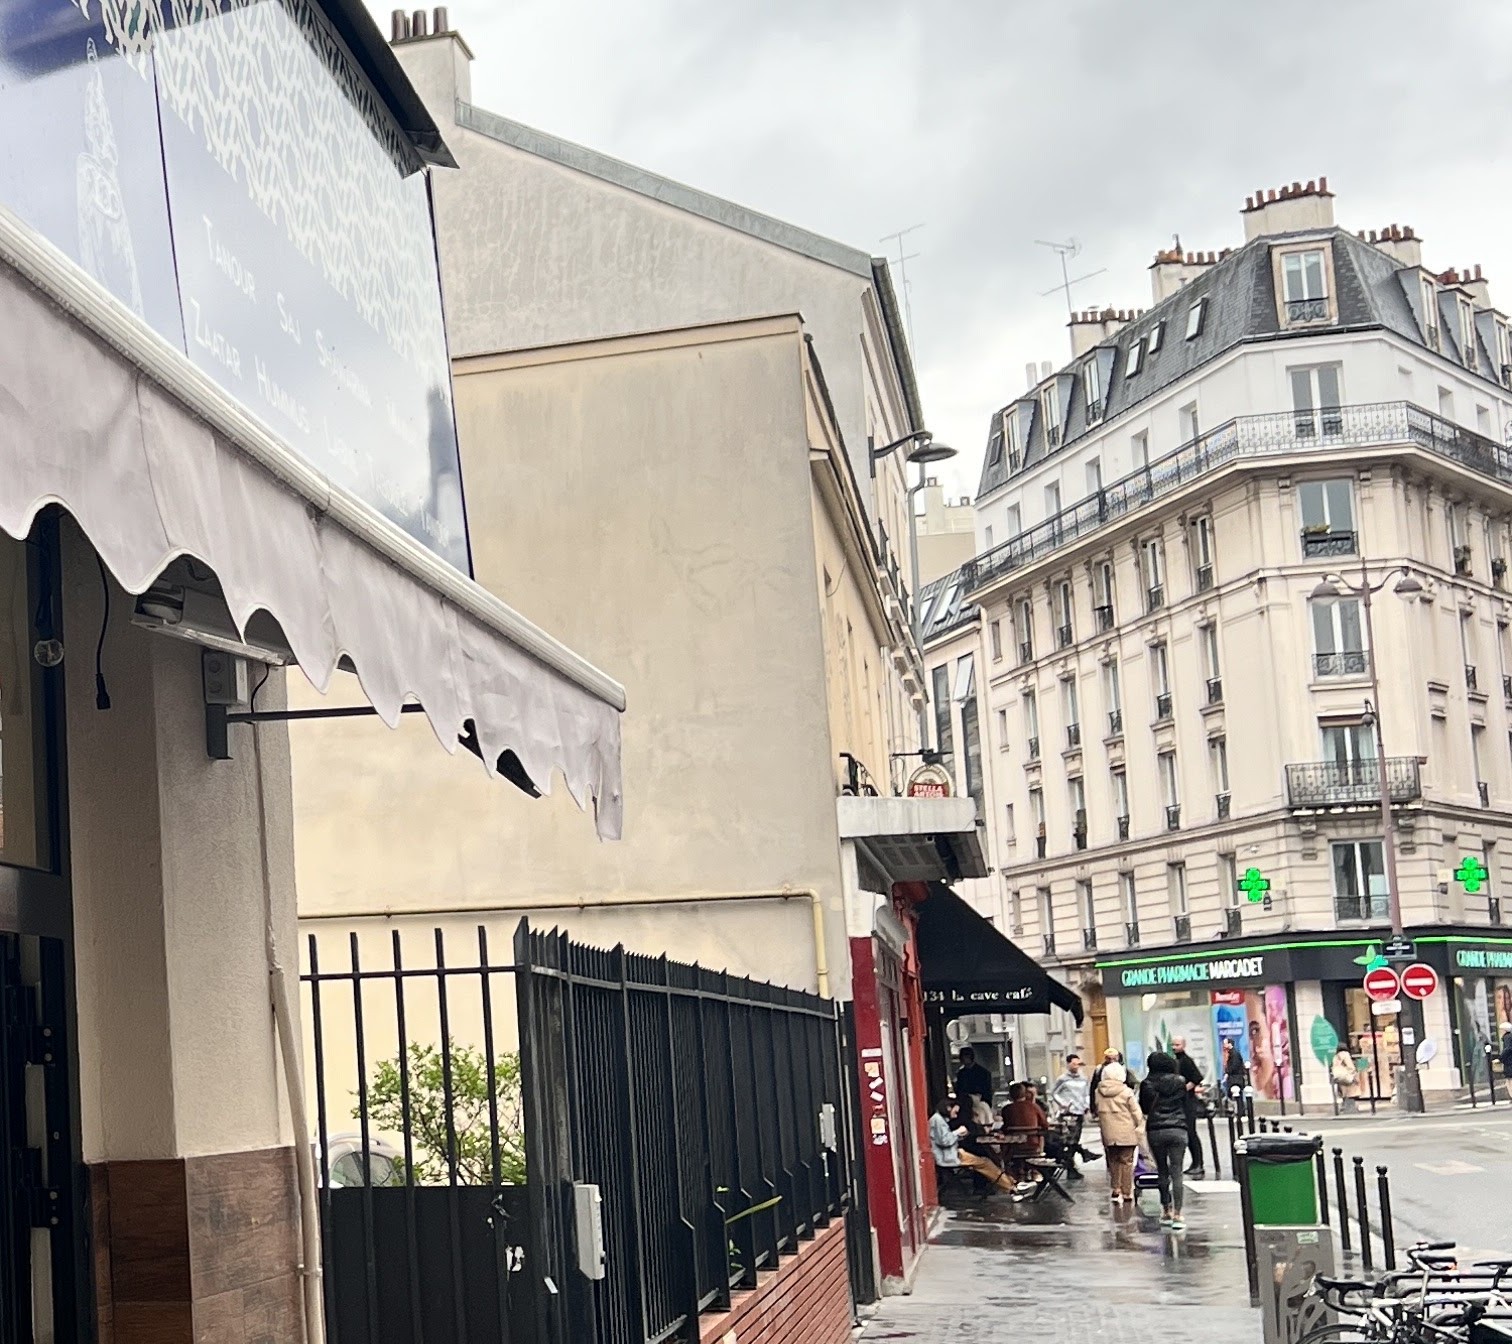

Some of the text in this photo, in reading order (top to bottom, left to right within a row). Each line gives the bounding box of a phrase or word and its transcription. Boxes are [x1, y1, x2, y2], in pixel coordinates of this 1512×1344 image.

[1121, 957, 1263, 987] GRANDE PHARMACIE MARCADET
[970, 991, 999, 1001] cave
